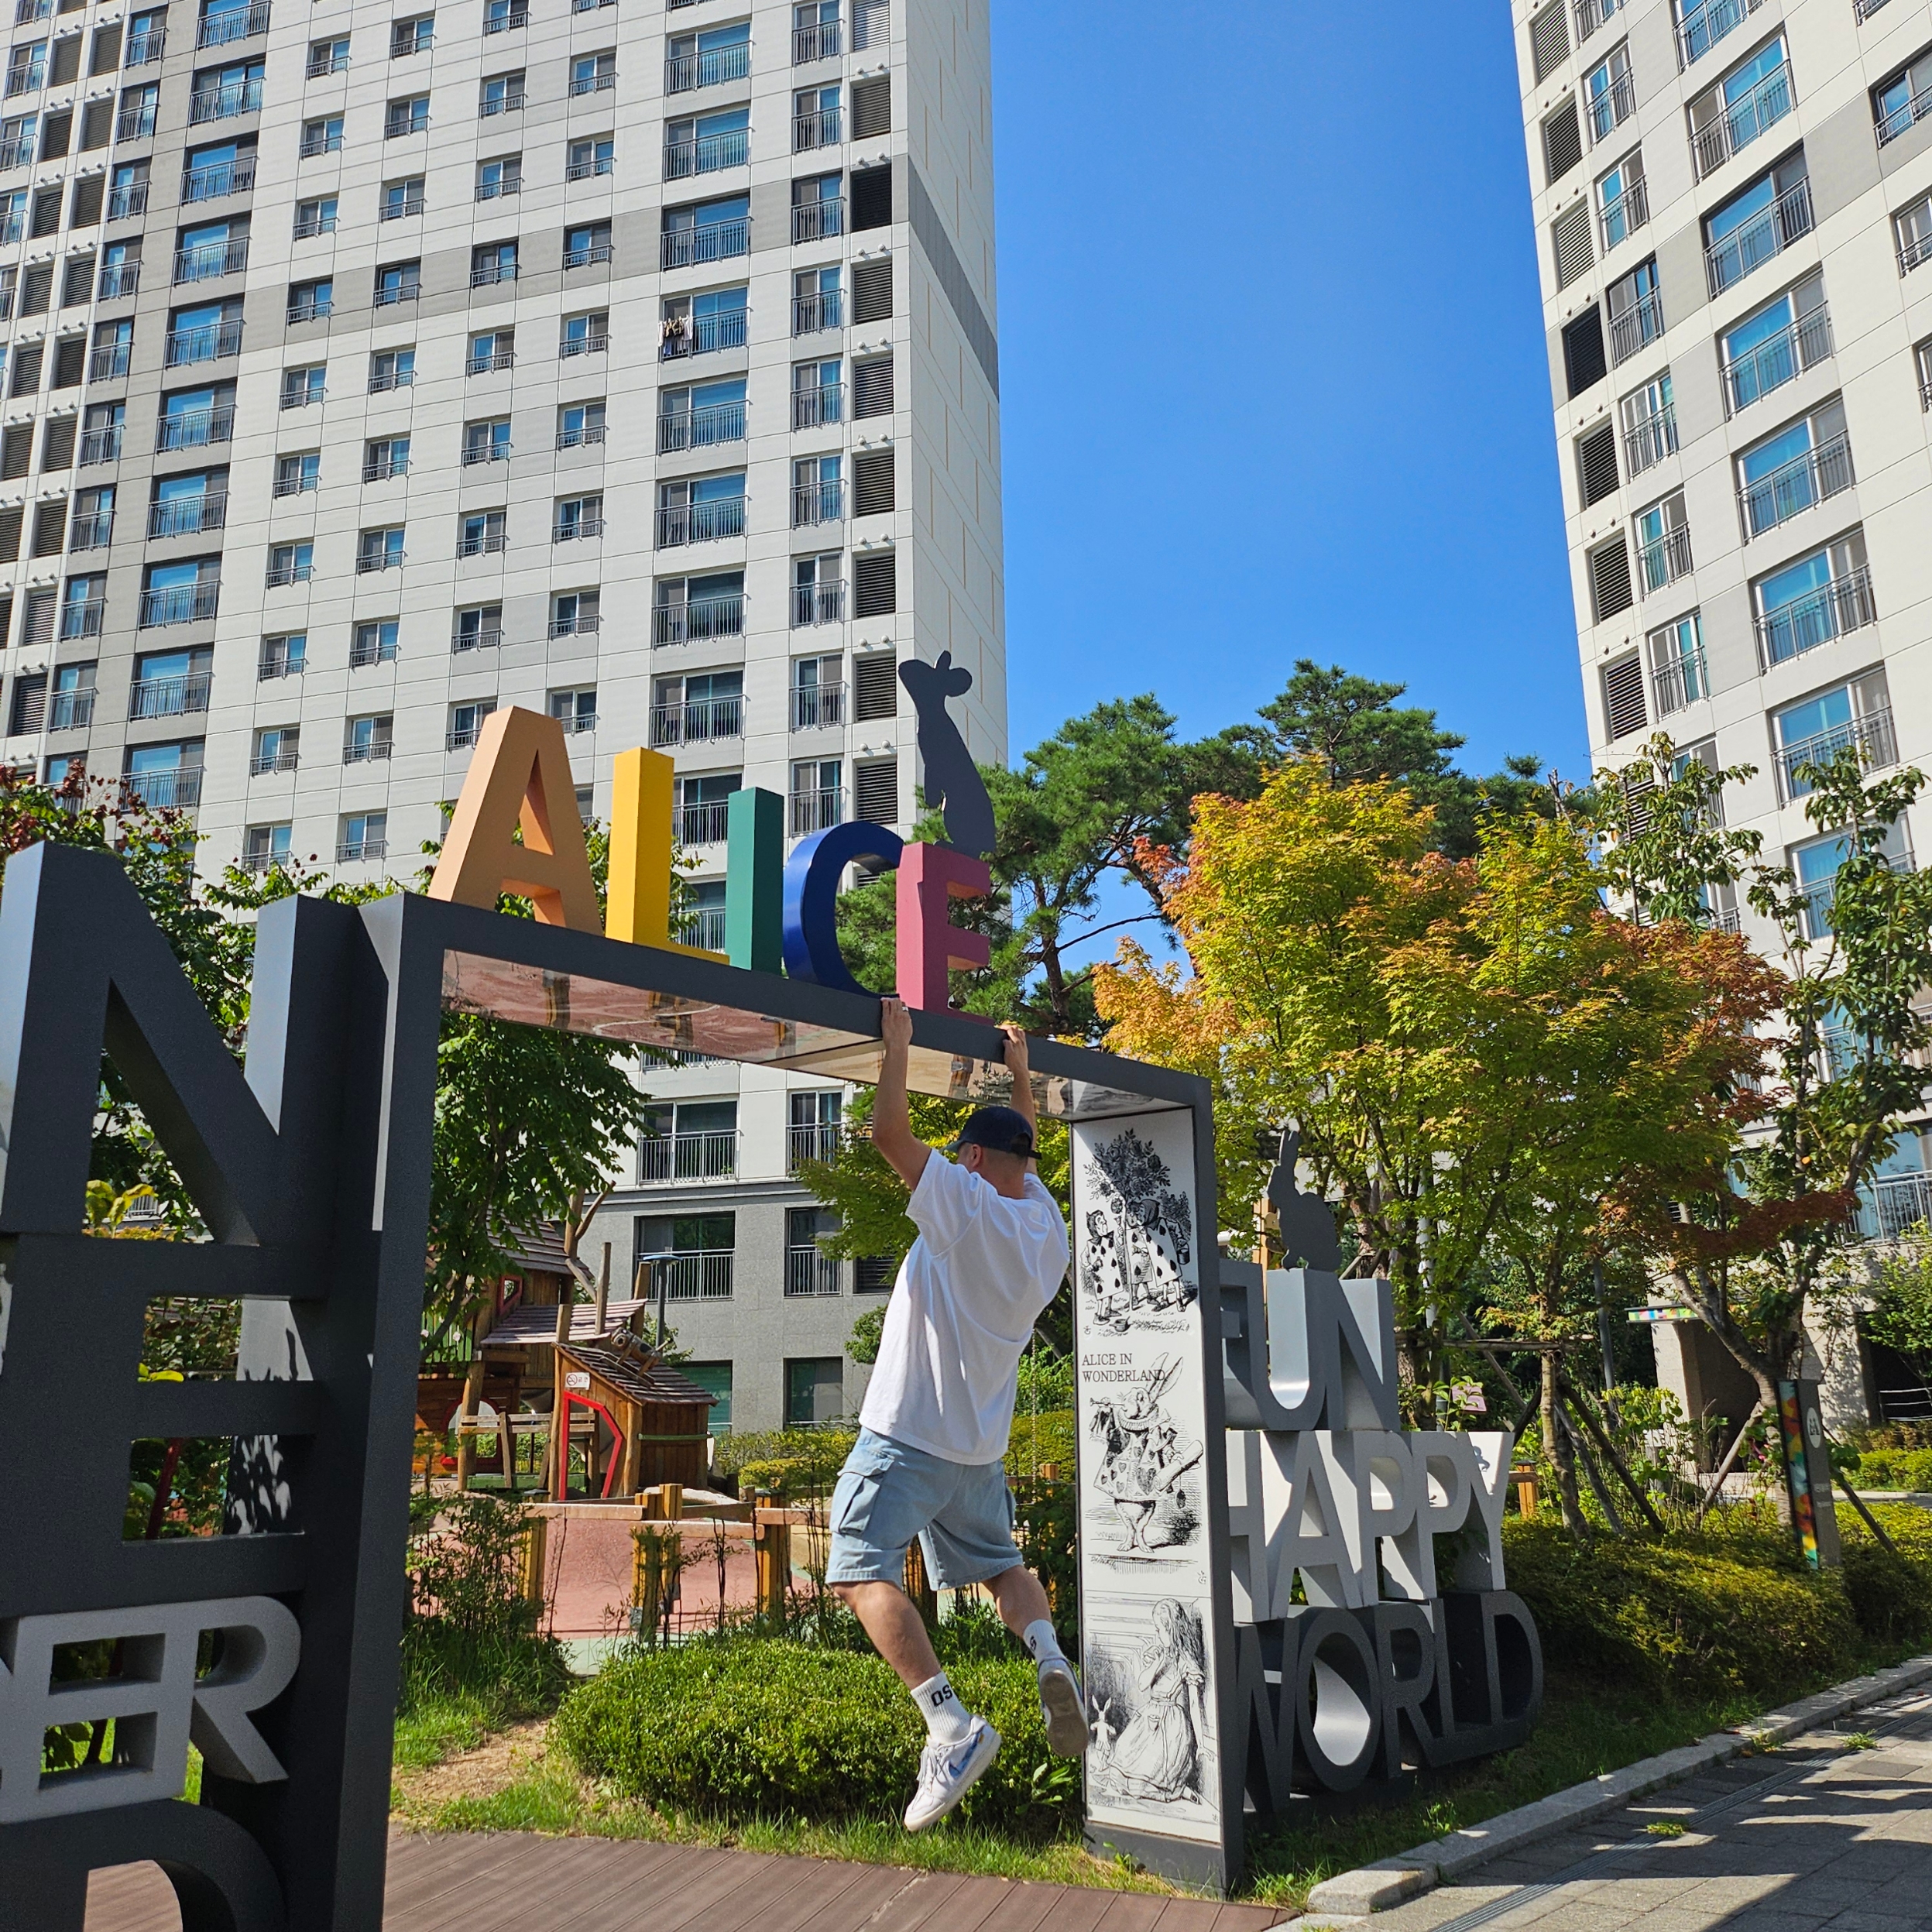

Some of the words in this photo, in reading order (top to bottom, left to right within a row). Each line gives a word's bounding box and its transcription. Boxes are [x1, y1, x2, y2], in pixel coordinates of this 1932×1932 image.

[427, 705, 1008, 1027] ALICE
[1082, 1354, 1116, 1366] ALICE
[1120, 1353, 1132, 1364] IN
[1082, 1369, 1165, 1383] WONDERLAND
[1225, 1430, 1515, 1624] HAPPY
[1233, 1590, 1544, 1818] WORLD
